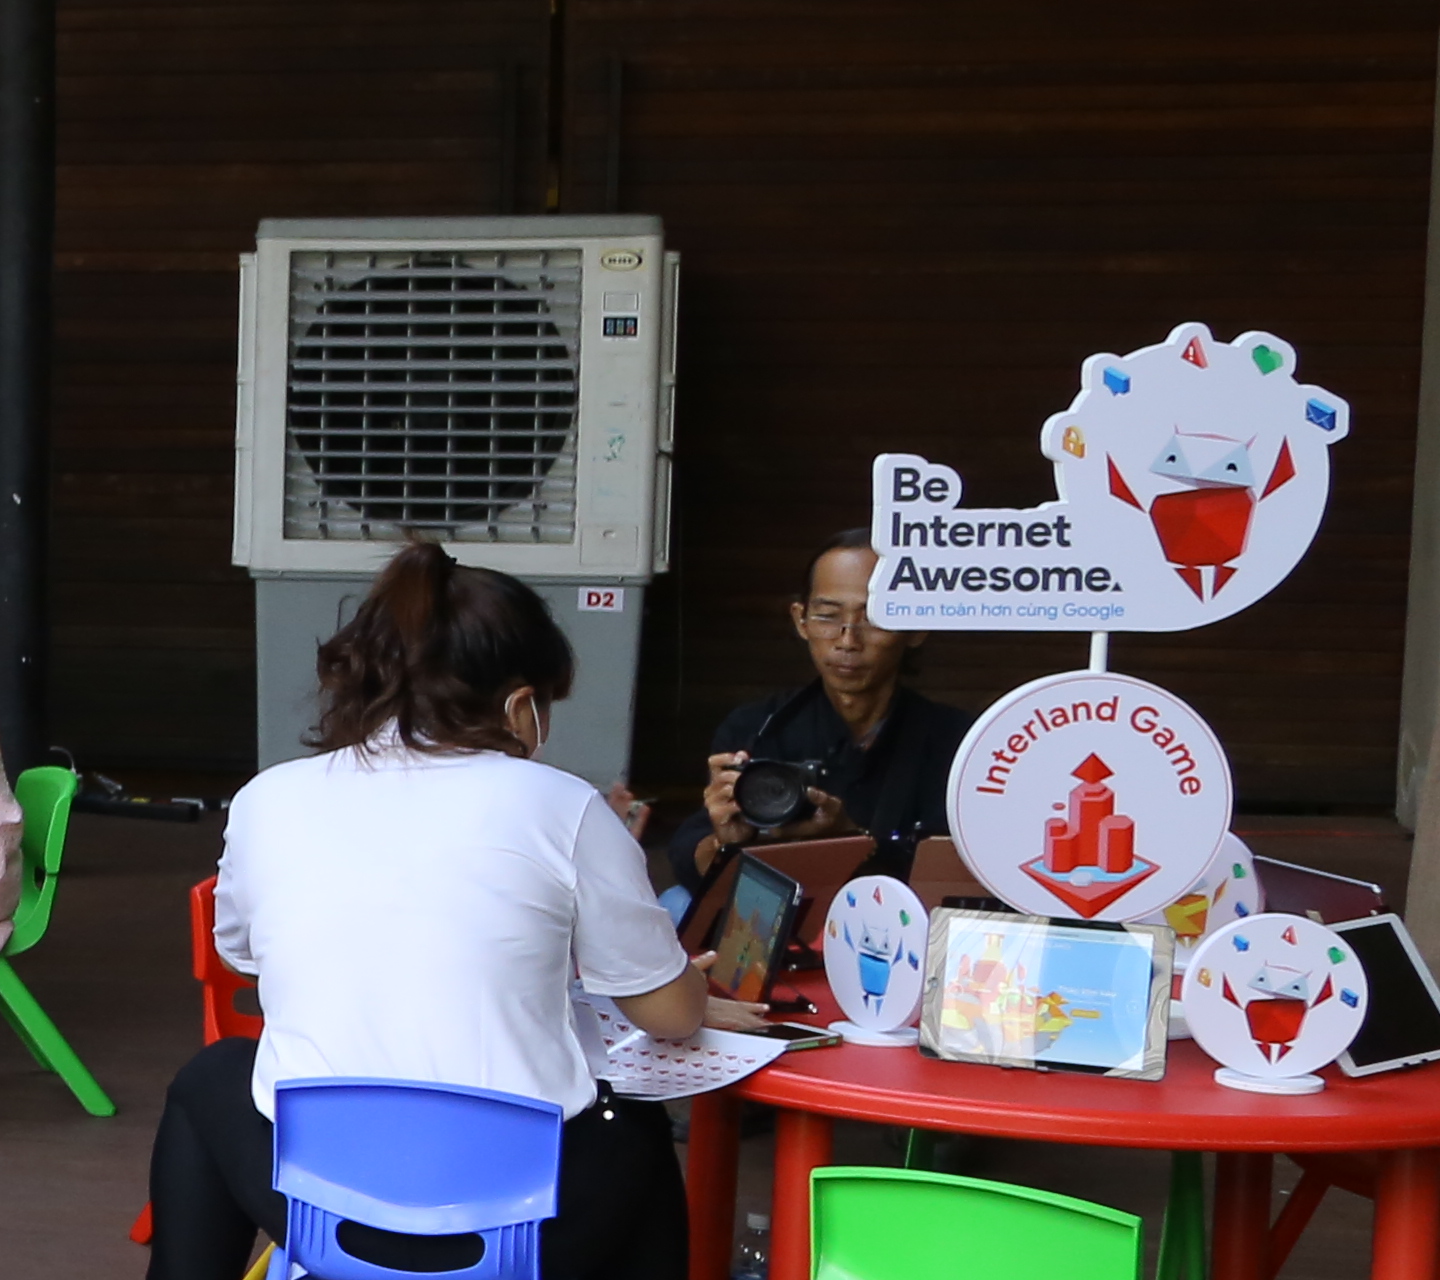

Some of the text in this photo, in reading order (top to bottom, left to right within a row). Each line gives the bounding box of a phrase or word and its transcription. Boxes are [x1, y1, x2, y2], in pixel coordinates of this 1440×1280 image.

[893, 467, 949, 502] Be
[892, 512, 1071, 548] Internet
[586, 591, 615, 608] D2
[886, 603, 911, 616] Em
[916, 605, 934, 616] an
[940, 602, 976, 616] toàn
[1017, 602, 1058, 620] cùng
[1063, 603, 1124, 620] Google
[976, 695, 1201, 796] Interland Game
